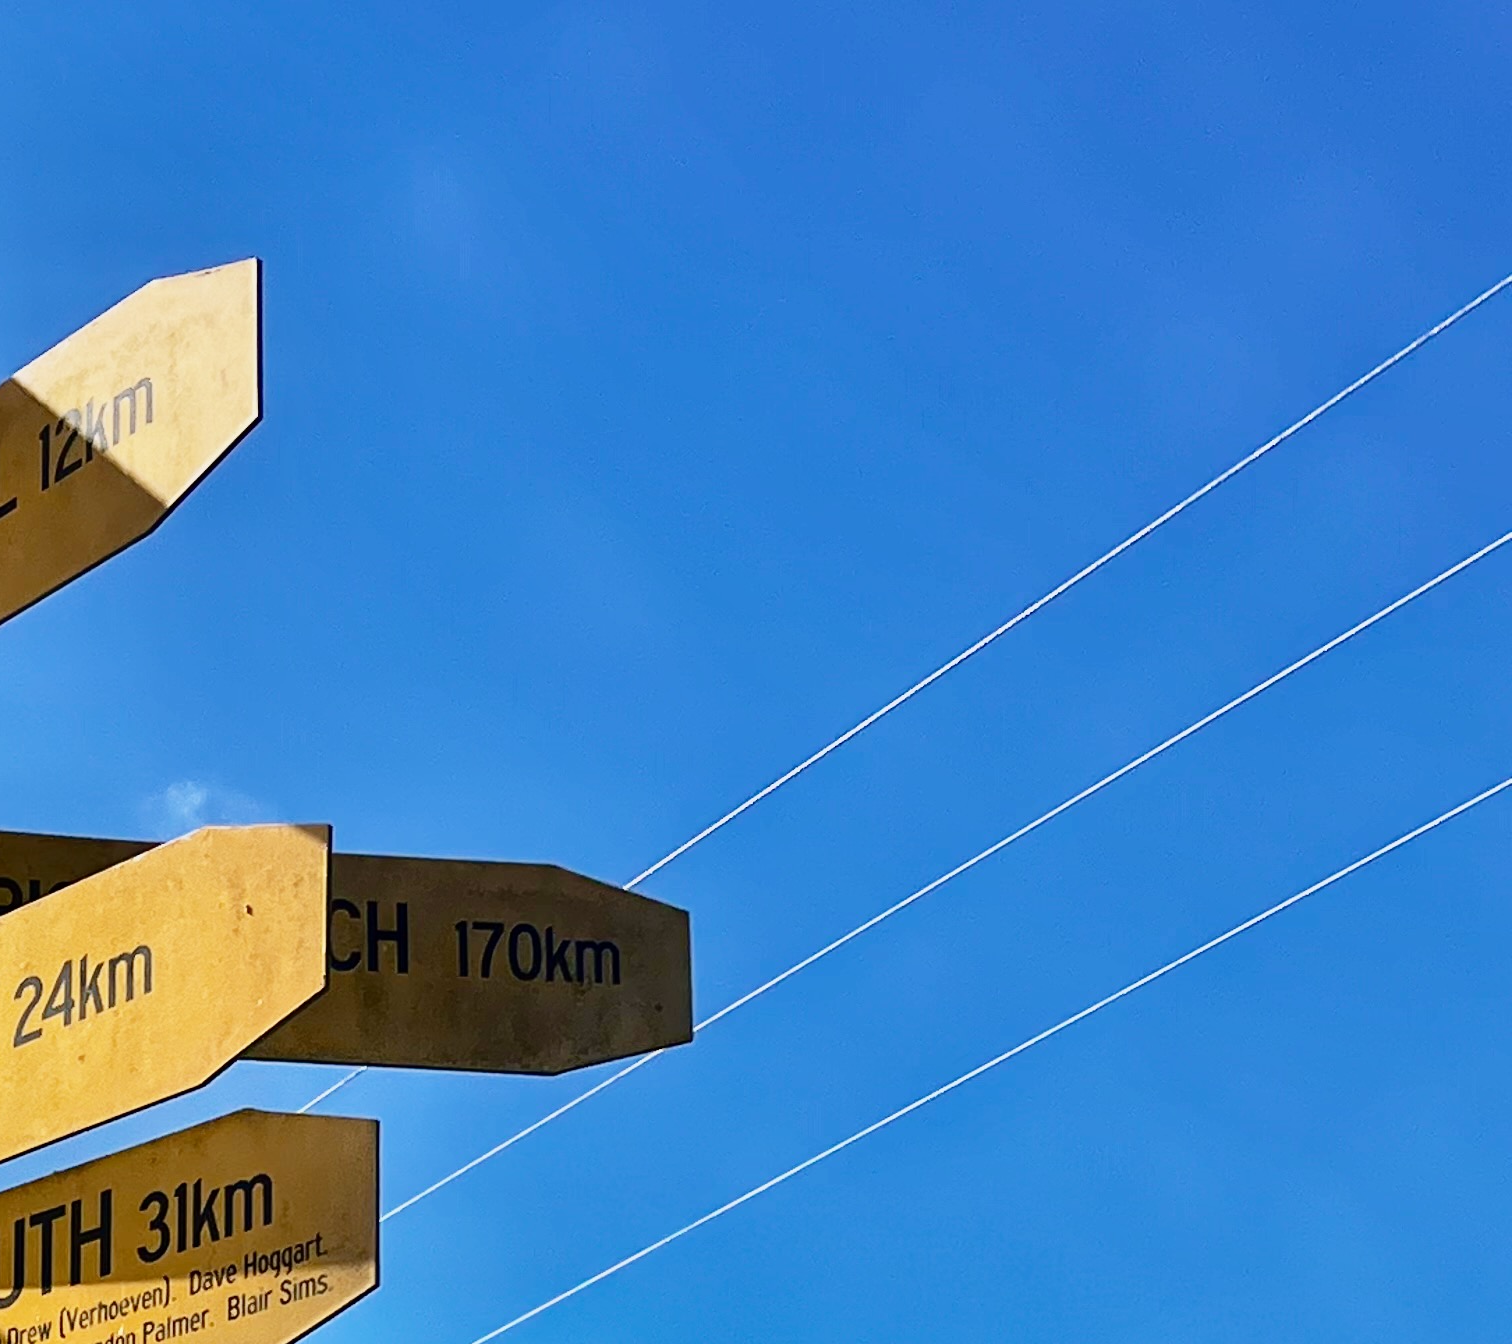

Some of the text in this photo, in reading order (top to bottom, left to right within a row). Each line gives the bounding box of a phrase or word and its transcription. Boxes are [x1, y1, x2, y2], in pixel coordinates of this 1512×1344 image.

[39, 377, 154, 491] 12km
[453, 920, 621, 986] 170km
[13, 945, 152, 1047] 24km
[138, 1172, 274, 1264] 31km
[59, 1275, 177, 1340] (Verhoeven).
[189, 1263, 237, 1297] Dave
[228, 1288, 273, 1321] Blair
[279, 1272, 334, 1306] Sims.
